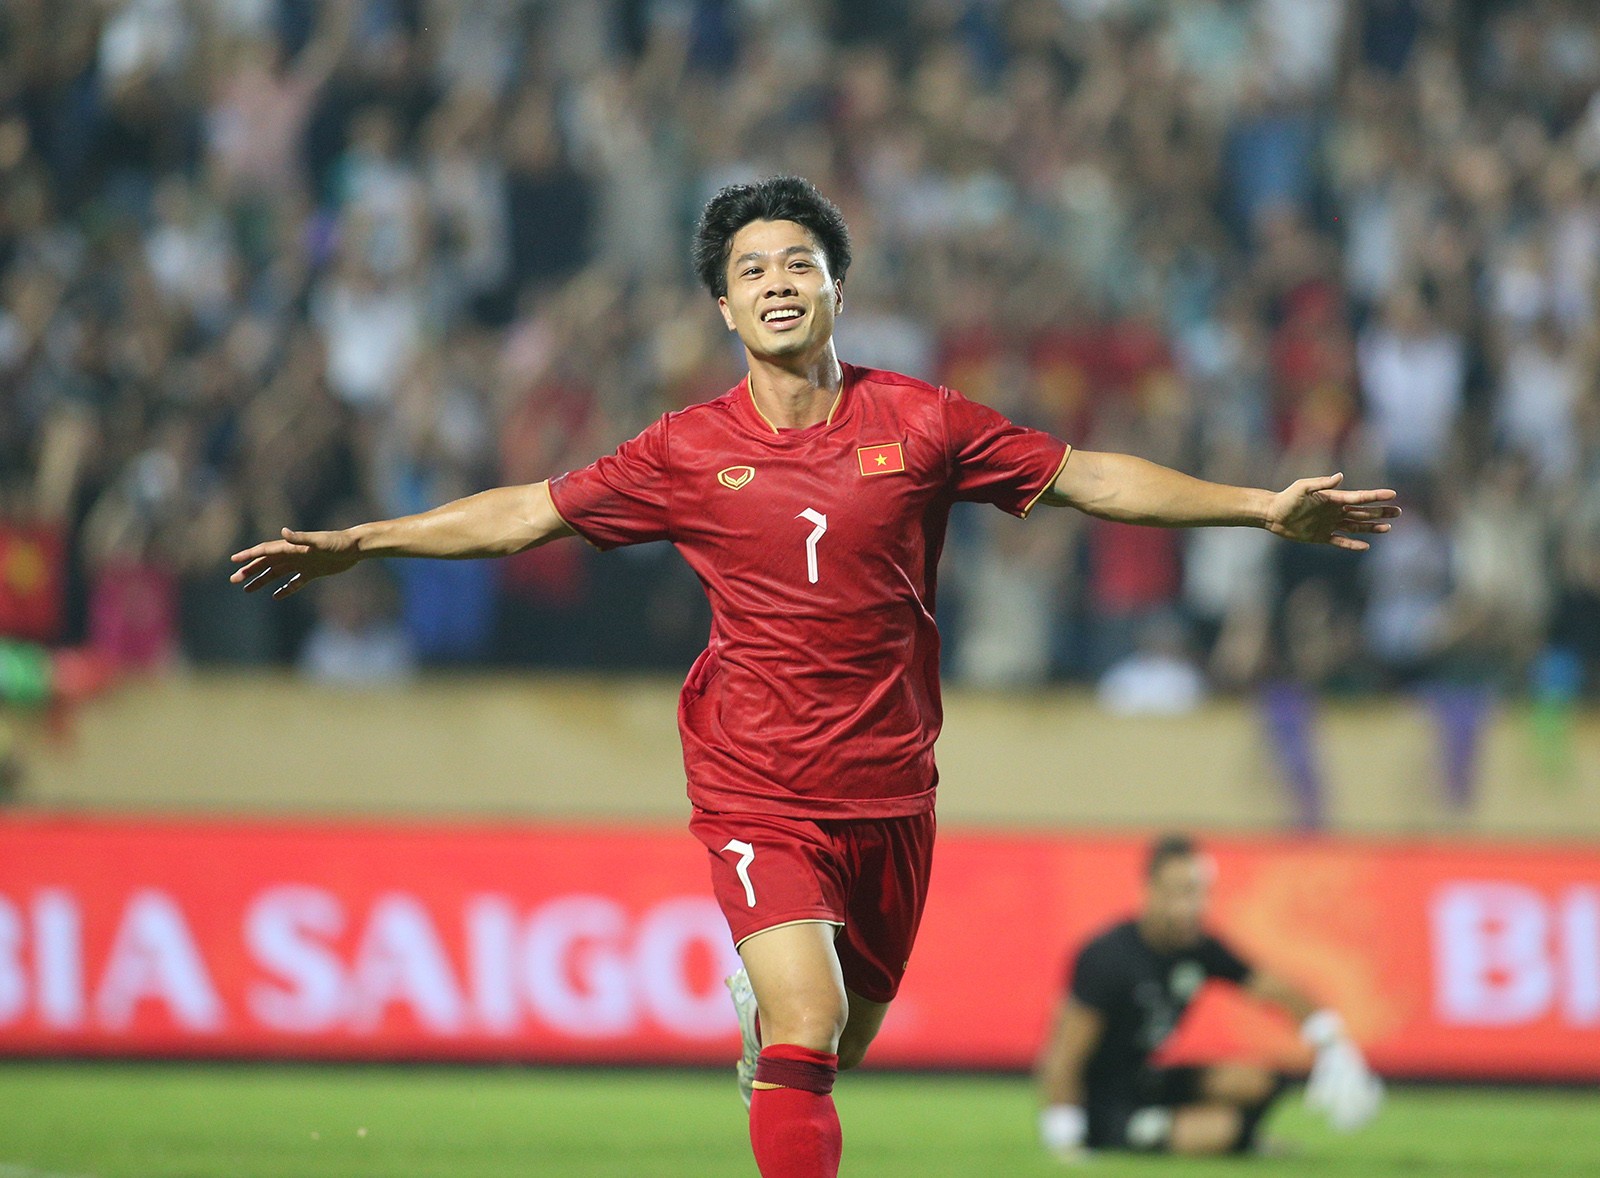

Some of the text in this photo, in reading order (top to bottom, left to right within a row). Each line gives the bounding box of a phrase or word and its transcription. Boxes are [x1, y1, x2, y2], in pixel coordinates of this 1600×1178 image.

[793, 507, 827, 584] 7
[720, 838, 755, 908] 7
[0, 883, 745, 1037] IA SAIGO
